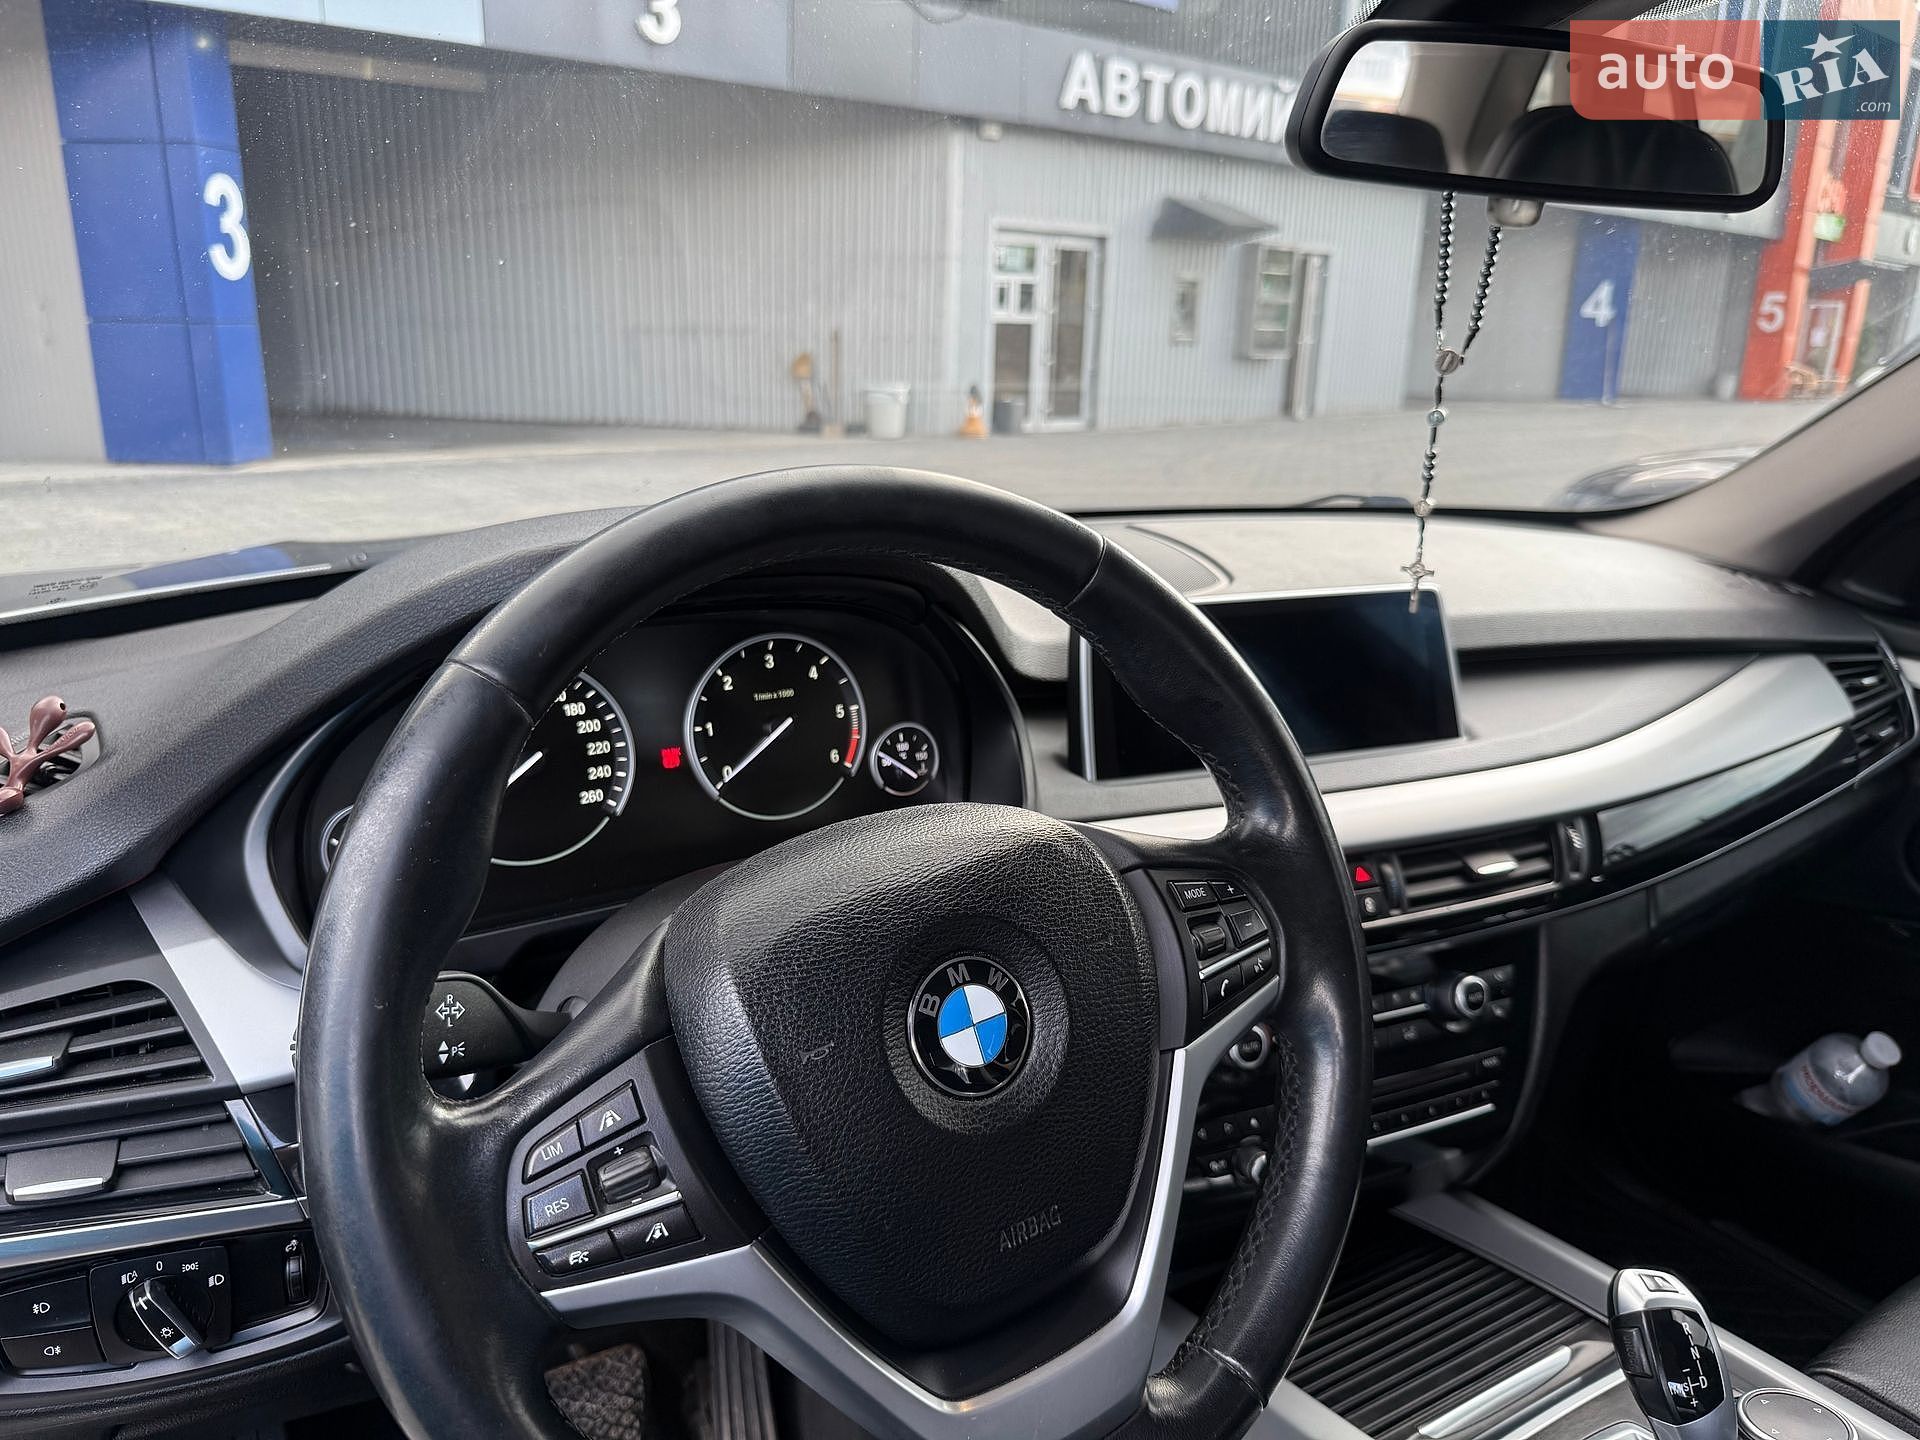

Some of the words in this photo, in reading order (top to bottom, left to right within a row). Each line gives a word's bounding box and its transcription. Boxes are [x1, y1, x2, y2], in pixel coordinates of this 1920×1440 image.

[634, 0, 682, 45] 3
[203, 172, 251, 281] 3
[1579, 279, 1616, 327] 4
[1756, 292, 1787, 333] 5
[763, 653, 775, 669] 3
[808, 664, 819, 680] 4
[722, 675, 733, 691] 2
[562, 702, 586, 716] 180
[835, 704, 845, 719] 5
[576, 719, 602, 735] 200
[705, 721, 714, 737] 1
[586, 740, 611, 756] 220
[829, 749, 840, 764] 6
[587, 765, 612, 781] 240
[578, 789, 604, 805] 260
[1184, 887, 1207, 900] MODE
[918, 963, 1009, 1018] BMW
[447, 994, 454, 1004] R
[448, 1016, 454, 1027] L
[451, 1046, 458, 1057] P
[541, 1142, 564, 1160] LIM
[544, 1197, 570, 1218] RES
[1000, 1204, 1061, 1253] AIRBAG
[155, 1260, 163, 1272] 0
[1682, 1322, 1692, 1335] R
[1690, 1345, 1700, 1361] N
[1699, 1376, 1708, 1389] D
